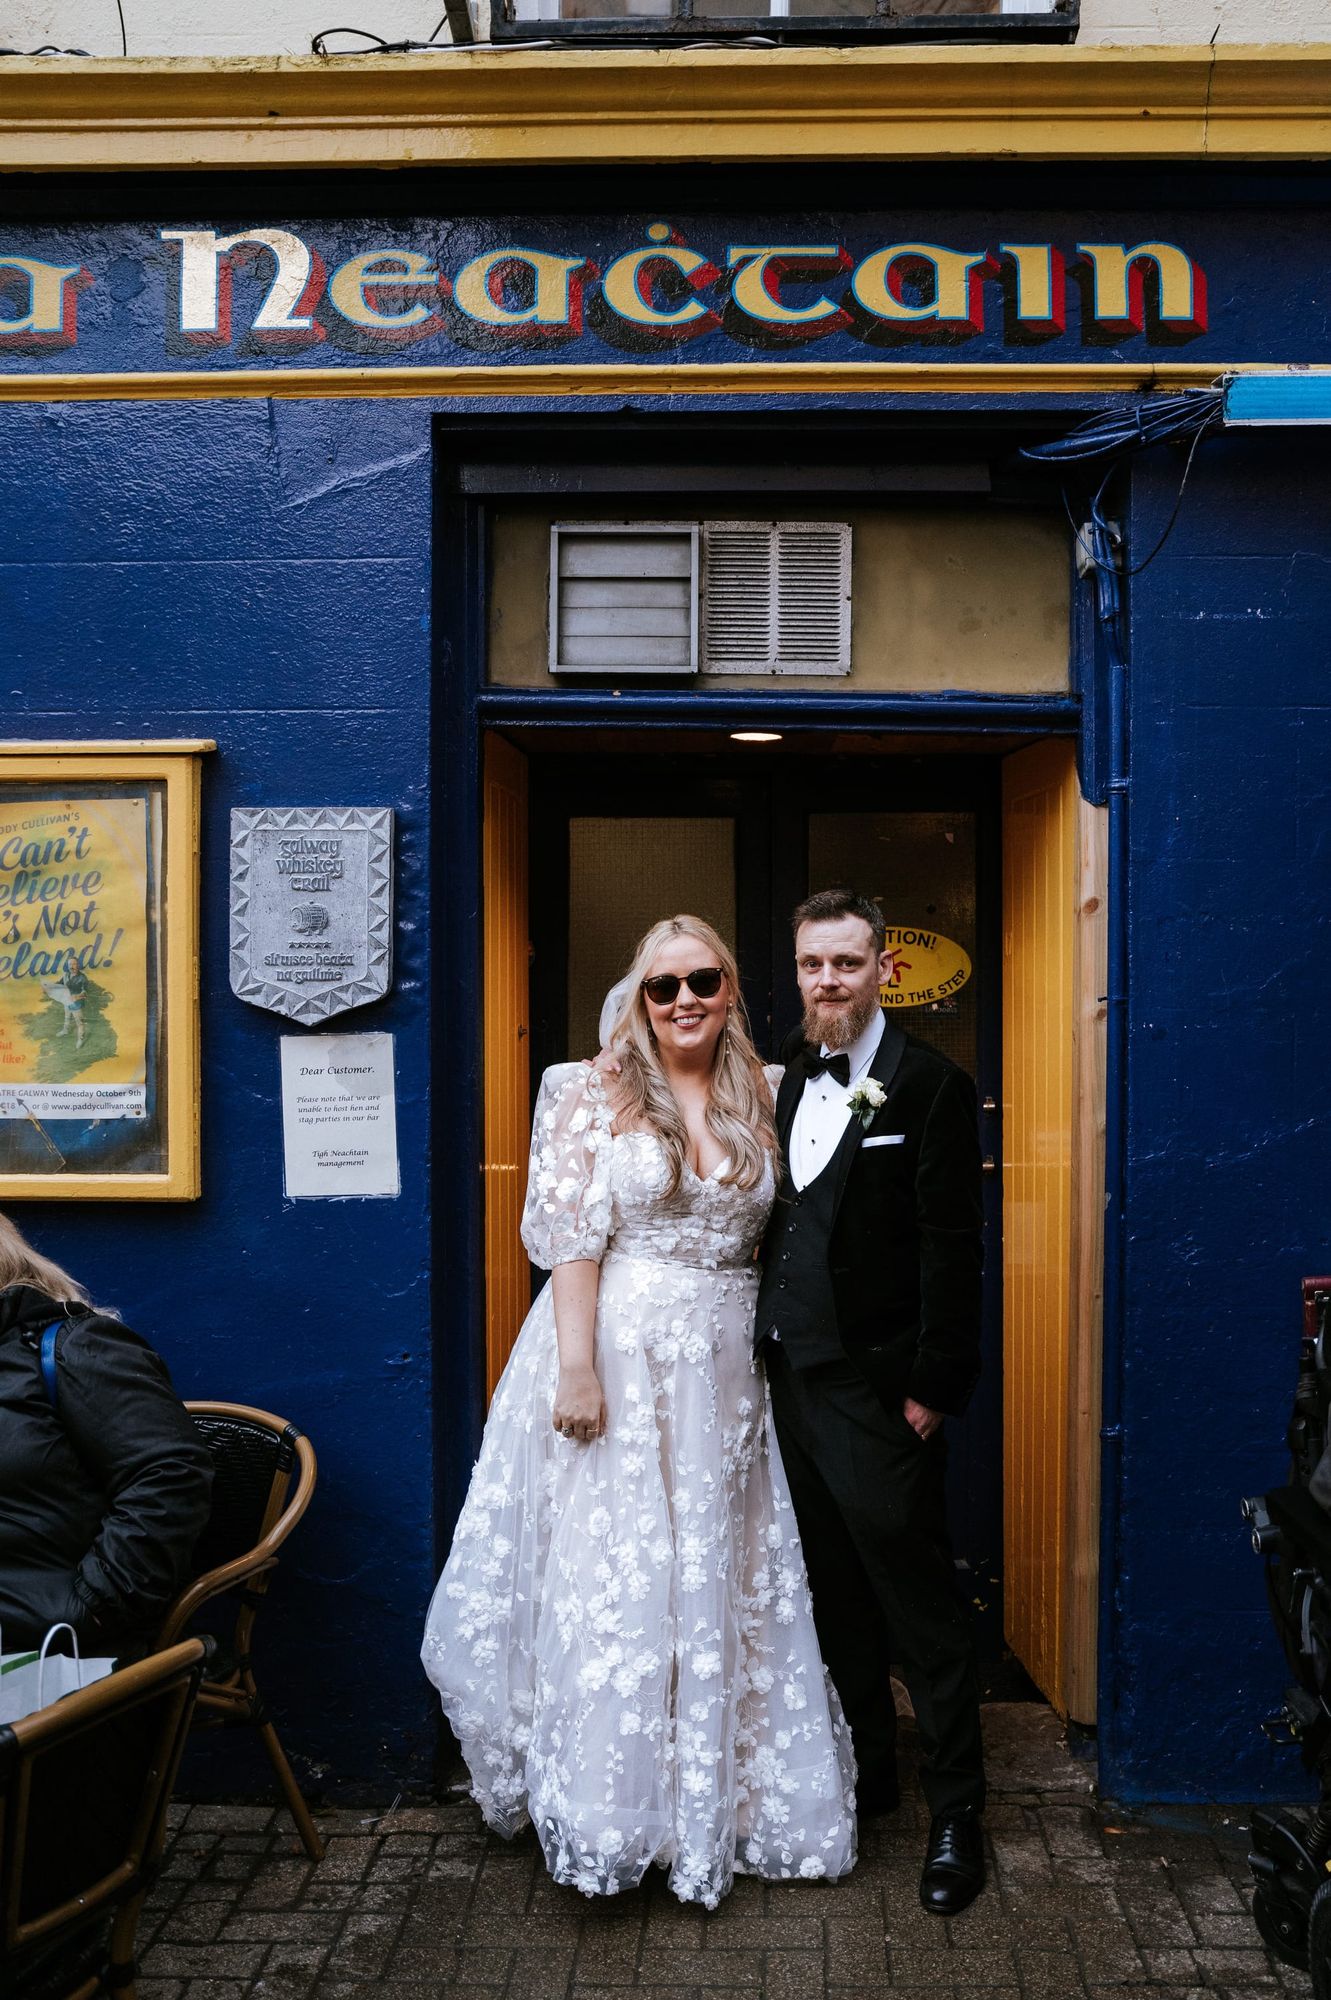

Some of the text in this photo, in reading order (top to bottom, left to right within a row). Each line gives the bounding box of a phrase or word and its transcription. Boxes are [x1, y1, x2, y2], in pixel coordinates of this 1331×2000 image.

[21, 812, 81, 830] CULLIVAN'S
[0, 826, 92, 871] Can't
[0, 901, 101, 944] 's Not
[885, 929, 937, 950] TION!
[880, 969, 966, 1004] IND THE STEP
[3, 1053, 26, 1064] like?
[299, 1067, 325, 1076] Dear
[51, 1090, 93, 1099] Wednesday
[128, 1089, 142, 1097] 9th
[338, 1094, 354, 1102] that
[51, 1102, 142, 1111] www.paddycullivan.com
[298, 1105, 322, 1113] unable
[333, 1104, 348, 1112] host
[350, 1103, 363, 1111] hen
[299, 1116, 314, 1125] stag
[366, 1113, 380, 1121] bar
[312, 1149, 369, 1159] Tigh Neachtain
[317, 1160, 365, 1168] management
